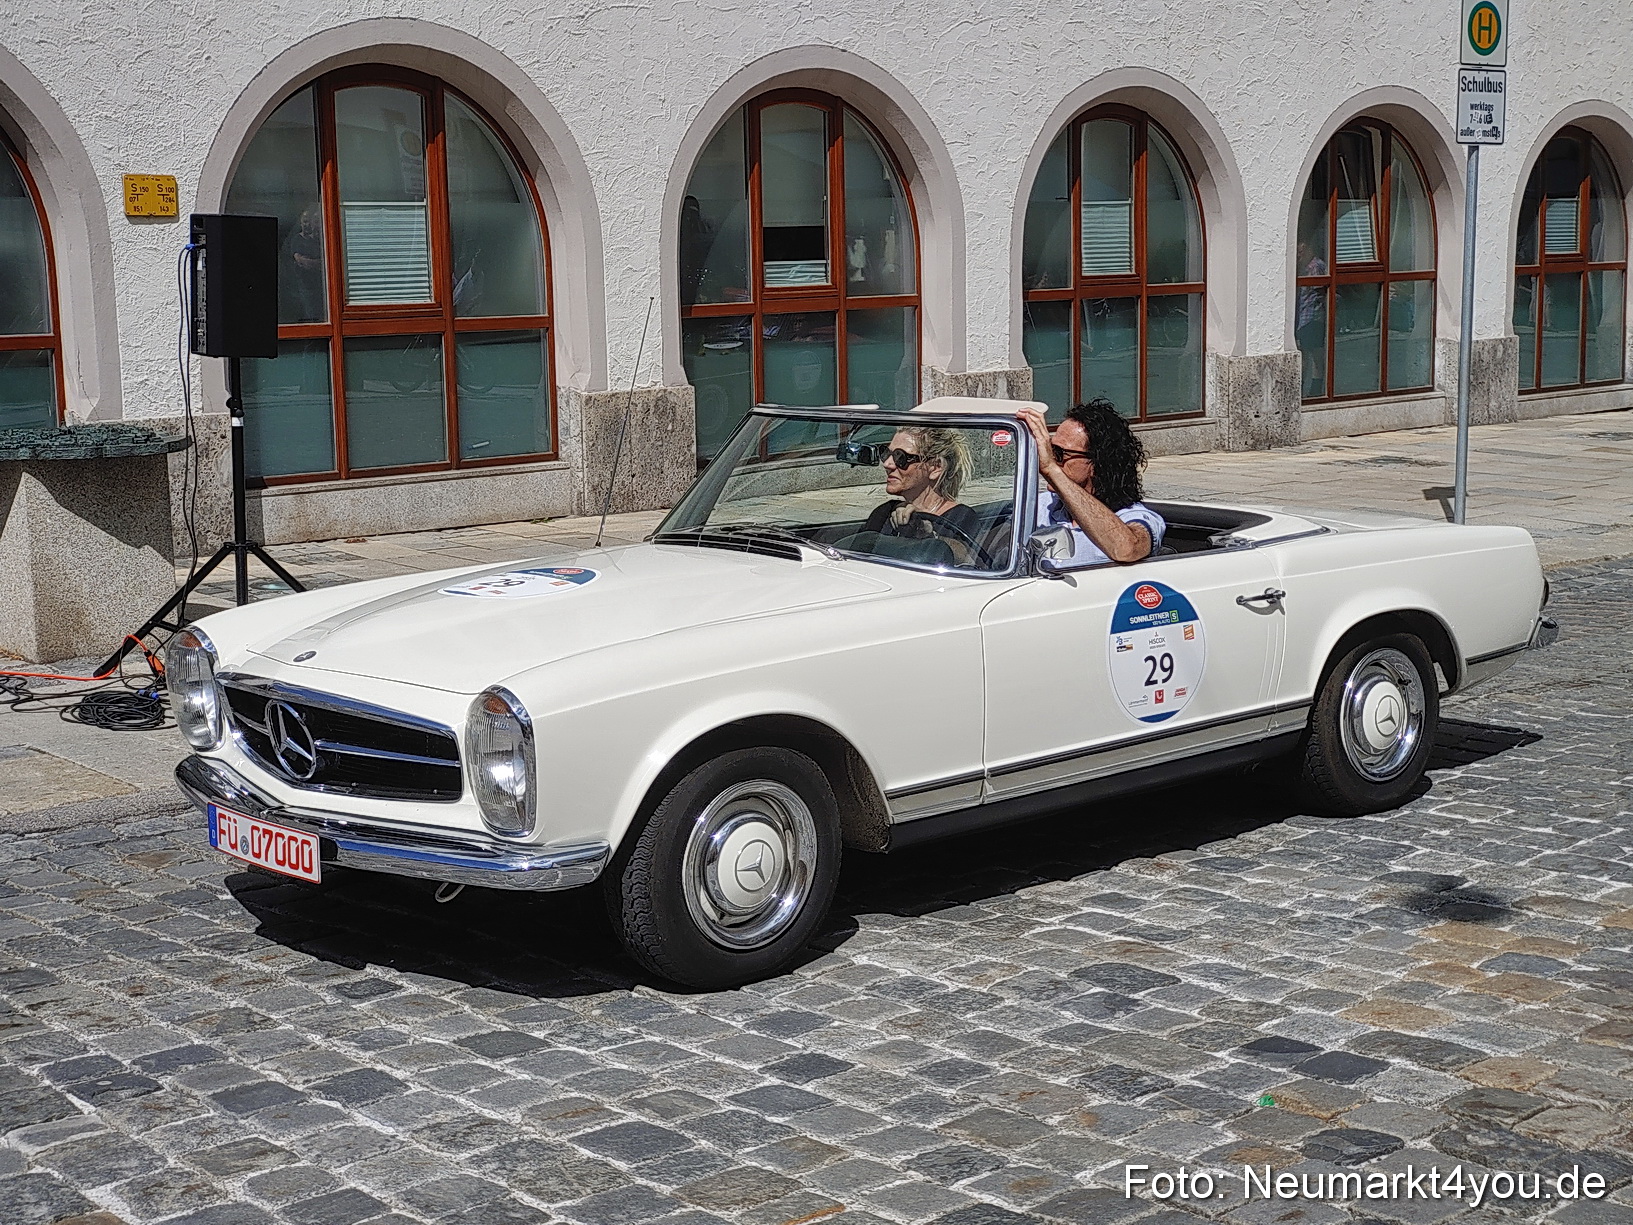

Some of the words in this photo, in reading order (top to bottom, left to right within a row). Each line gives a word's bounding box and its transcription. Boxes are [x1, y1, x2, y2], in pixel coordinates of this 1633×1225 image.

[1477, 12, 1493, 44] H
[1460, 76, 1503, 94] Schulbus
[1470, 101, 1494, 113] werktags
[1460, 126, 1475, 137] außer
[131, 183, 138, 192] S
[157, 183, 164, 192] S
[1129, 612, 1170, 624] SONNLEITNER
[1149, 637, 1166, 645] HISCOX
[1144, 652, 1175, 687] 29
[218, 812, 239, 852] FÜ
[251, 825, 313, 874] 07000
